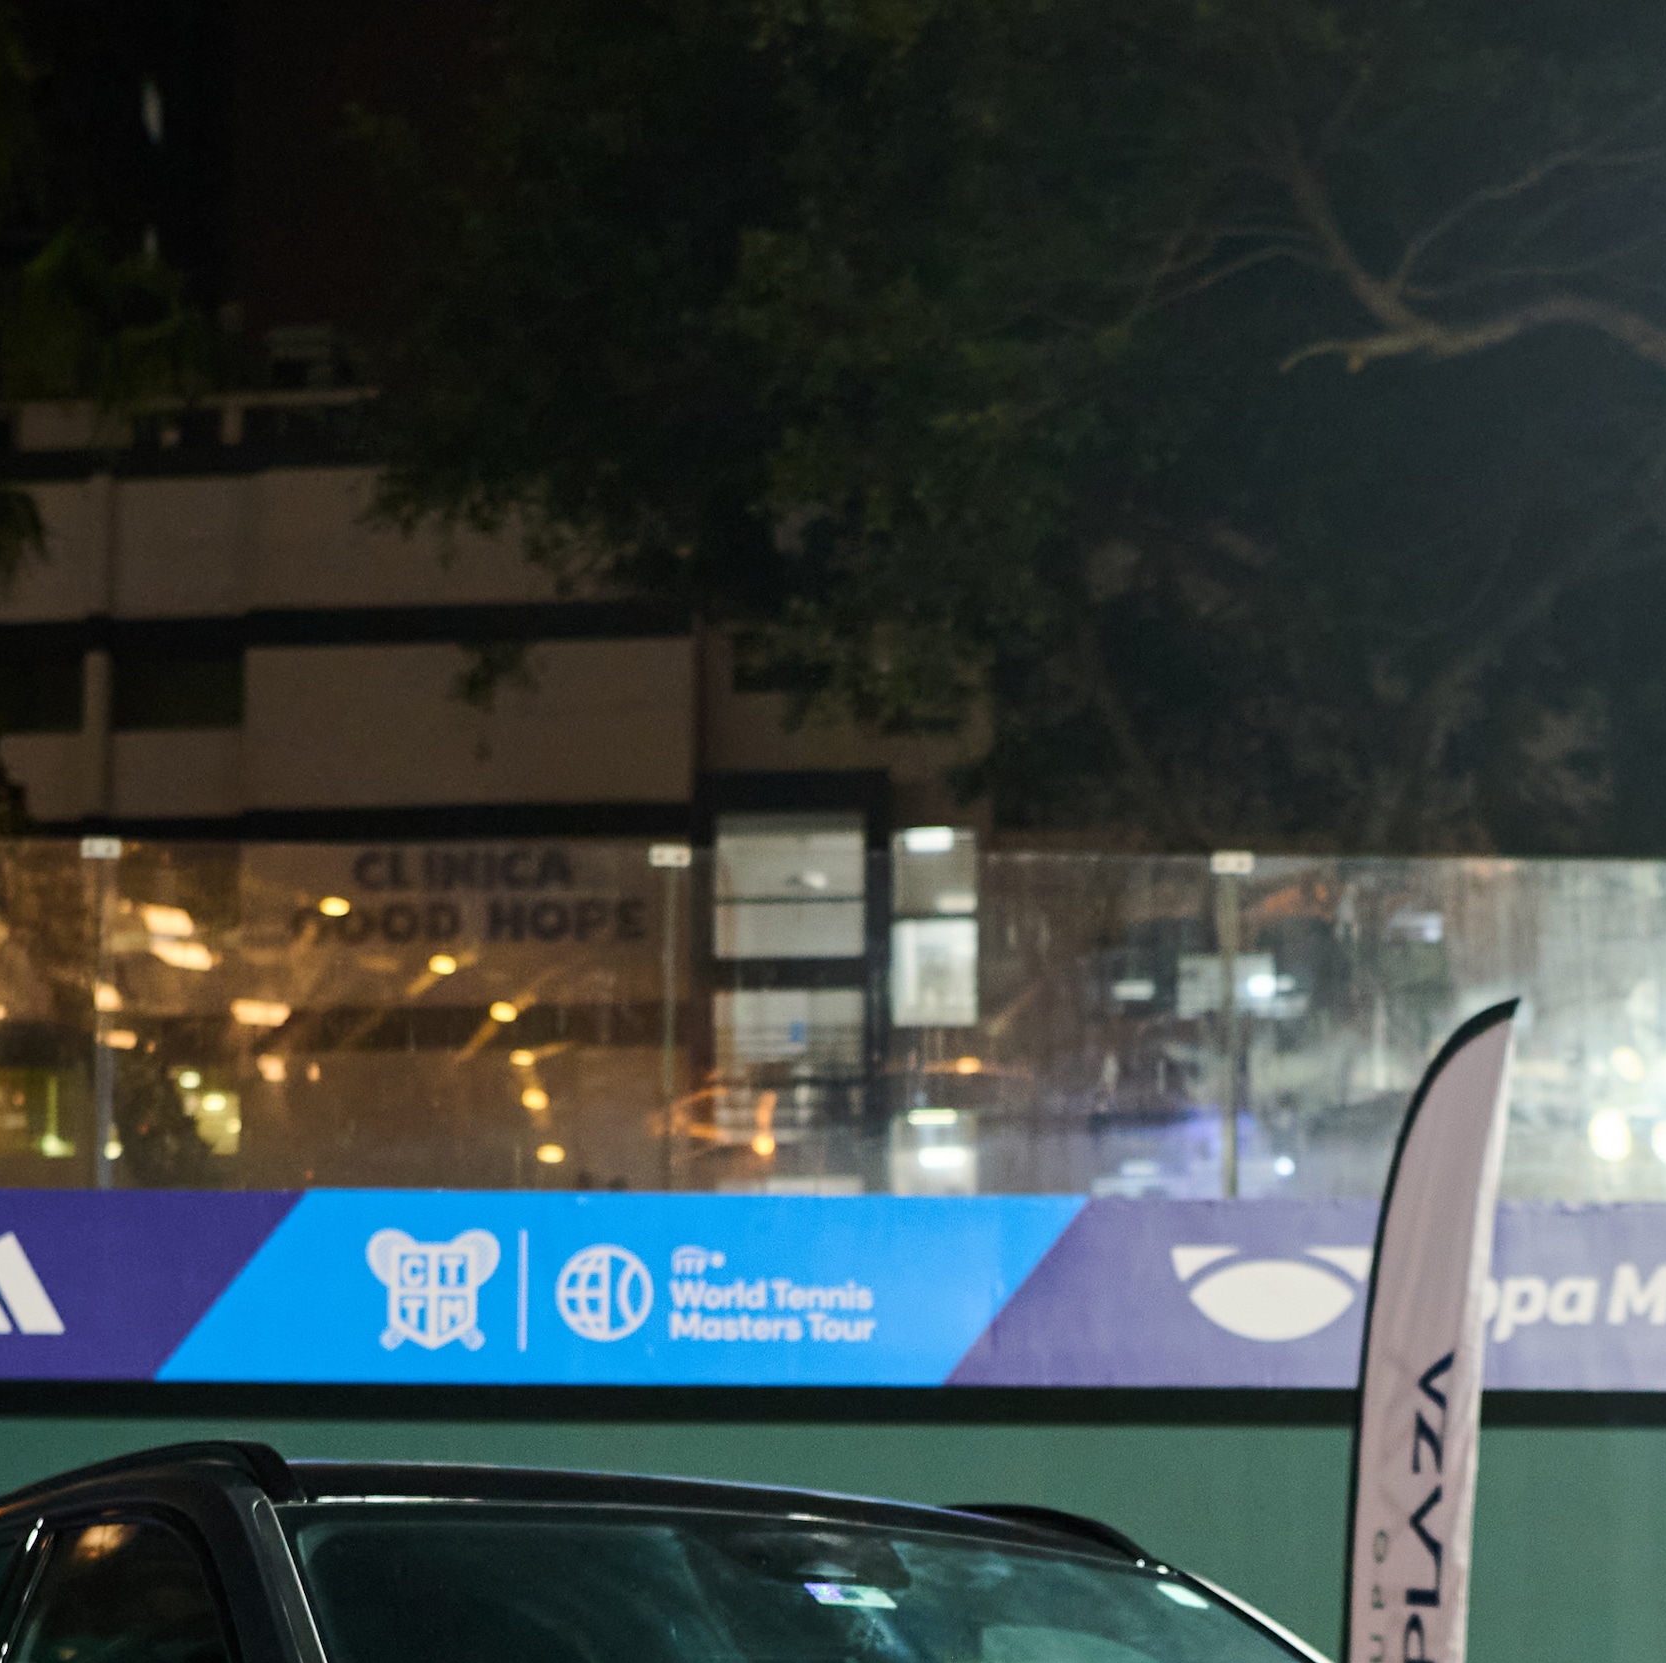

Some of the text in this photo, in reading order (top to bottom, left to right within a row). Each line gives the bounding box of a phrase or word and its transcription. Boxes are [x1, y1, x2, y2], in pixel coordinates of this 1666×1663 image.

[487, 900, 646, 943] HOPE
[669, 1279, 874, 1311] World Tennis
[1482, 1275, 1599, 1342] pa
[669, 1311, 877, 1342] Masters Tour
